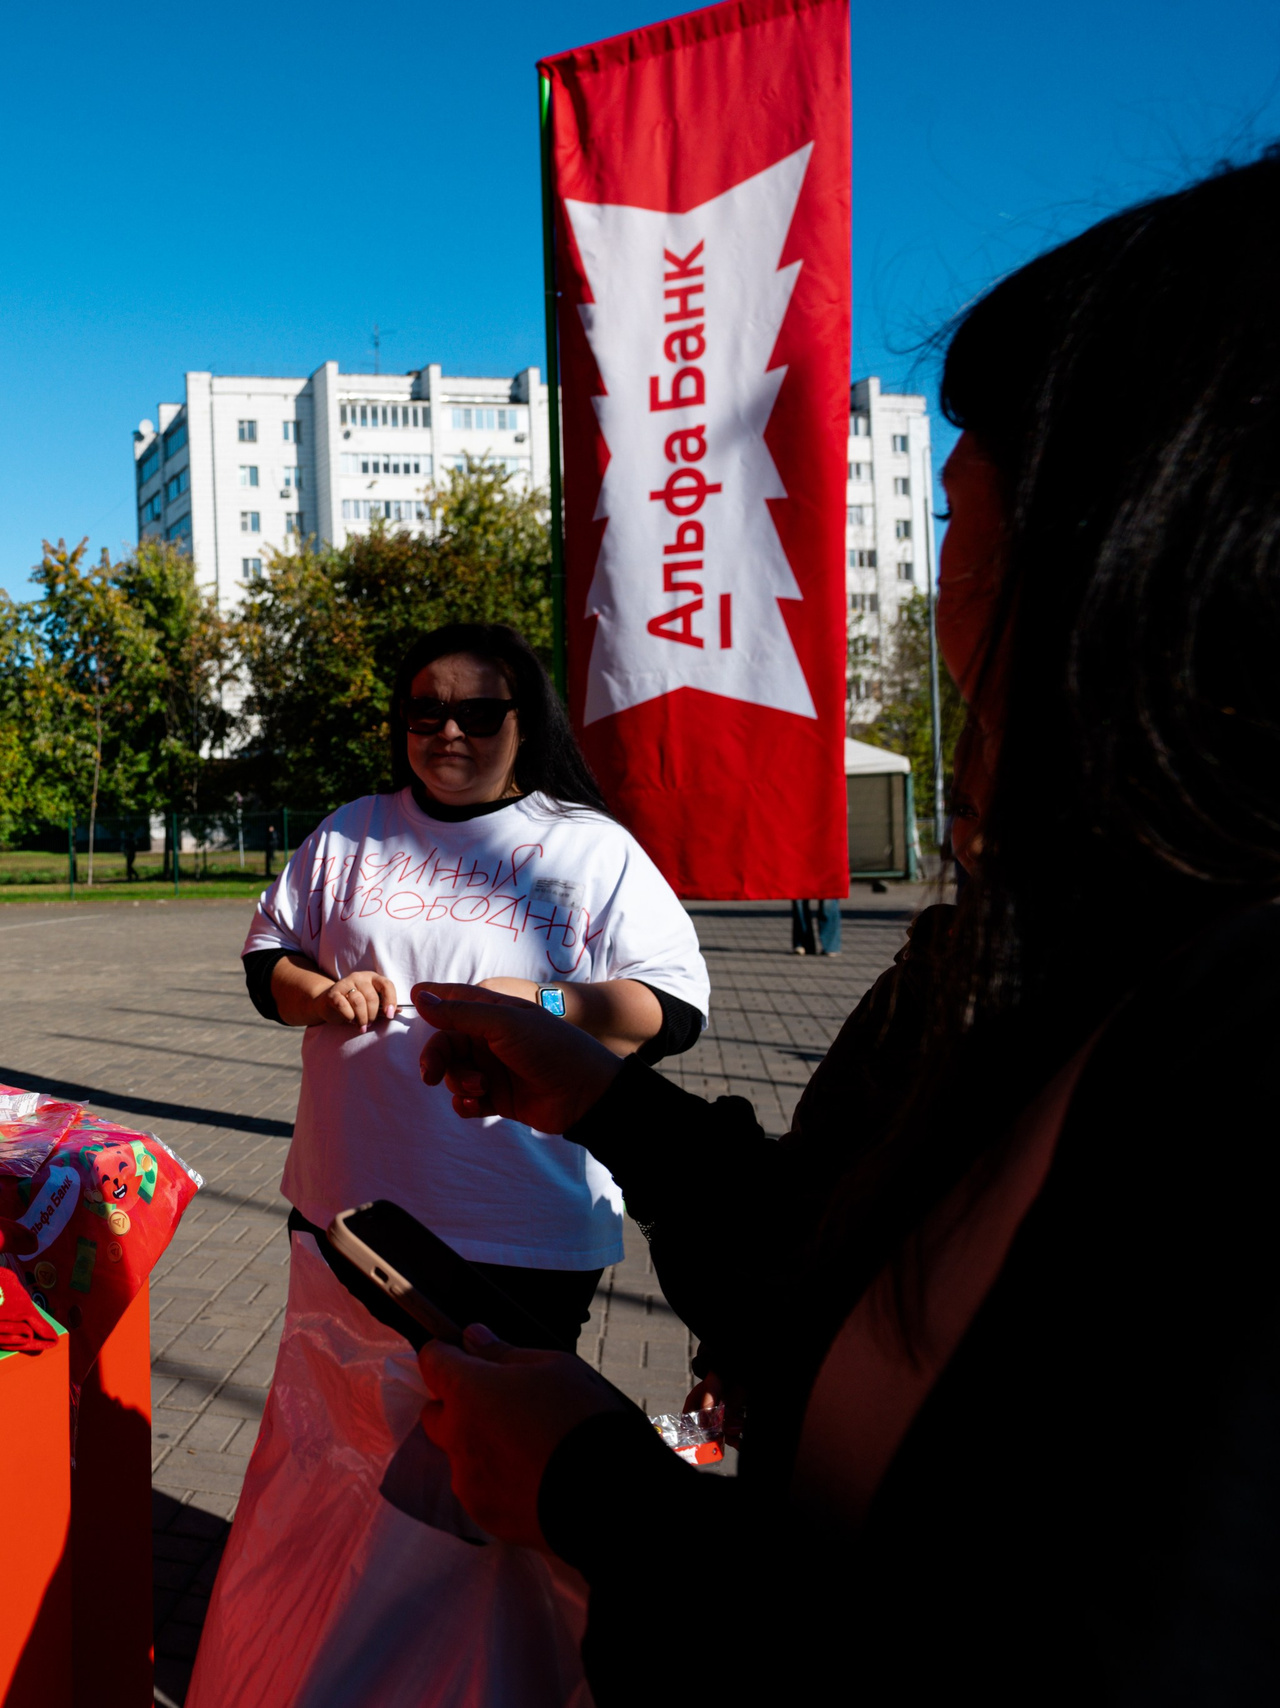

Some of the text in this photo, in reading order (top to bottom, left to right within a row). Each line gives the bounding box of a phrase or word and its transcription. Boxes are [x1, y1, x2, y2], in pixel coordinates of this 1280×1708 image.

[647, 238, 732, 650] Альфа Банк
[31, 1175, 74, 1236] льфа Банк
